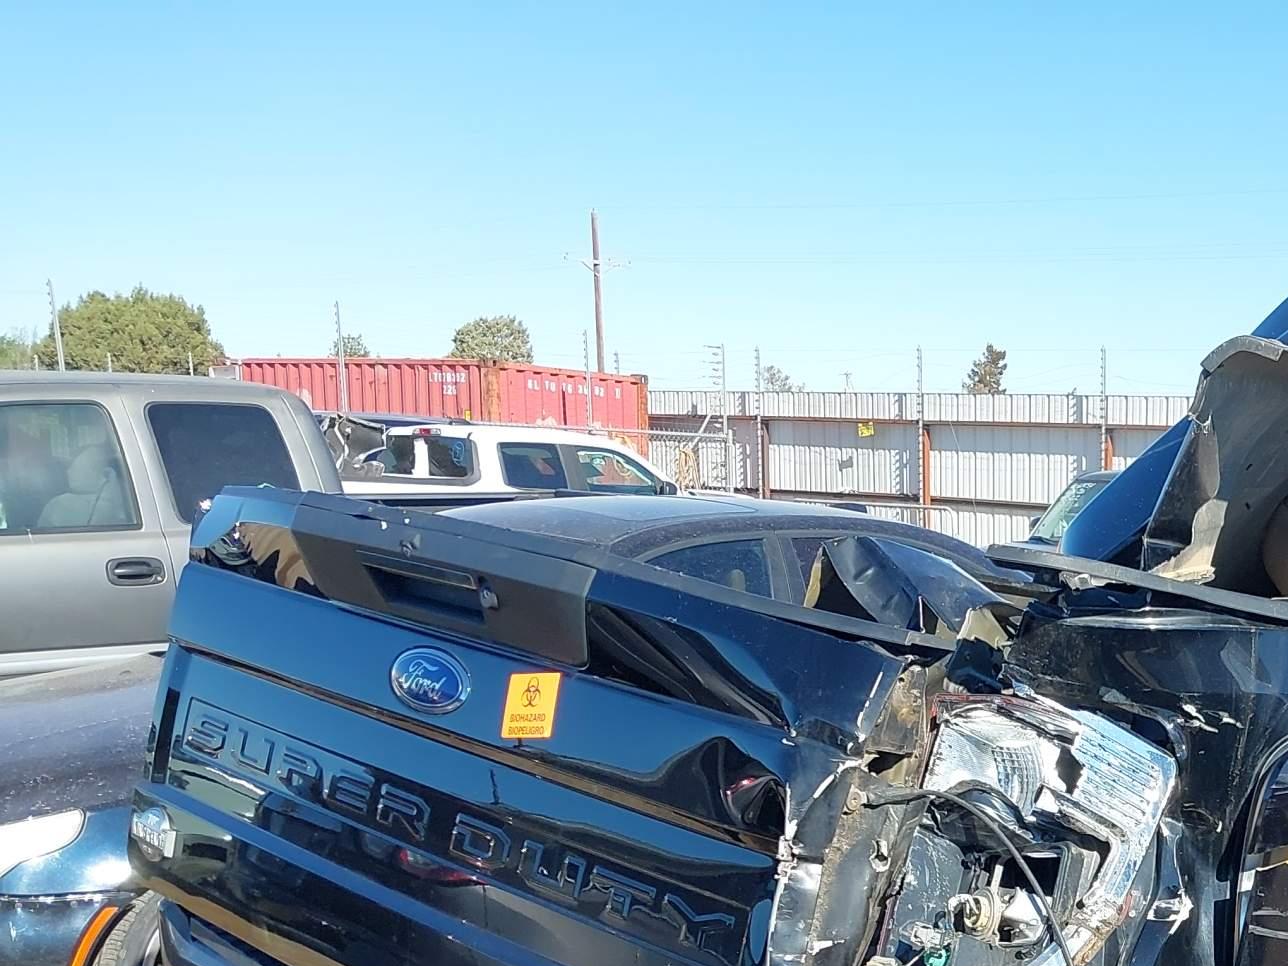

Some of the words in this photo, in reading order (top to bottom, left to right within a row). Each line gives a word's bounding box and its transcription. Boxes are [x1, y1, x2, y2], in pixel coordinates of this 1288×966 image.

[398, 659, 446, 700] Ford
[508, 725, 545, 735] BIOPELIGRO
[510, 713, 546, 722] BIOHAZARD
[187, 712, 433, 842] SUPER
[448, 810, 736, 952] DUTY
